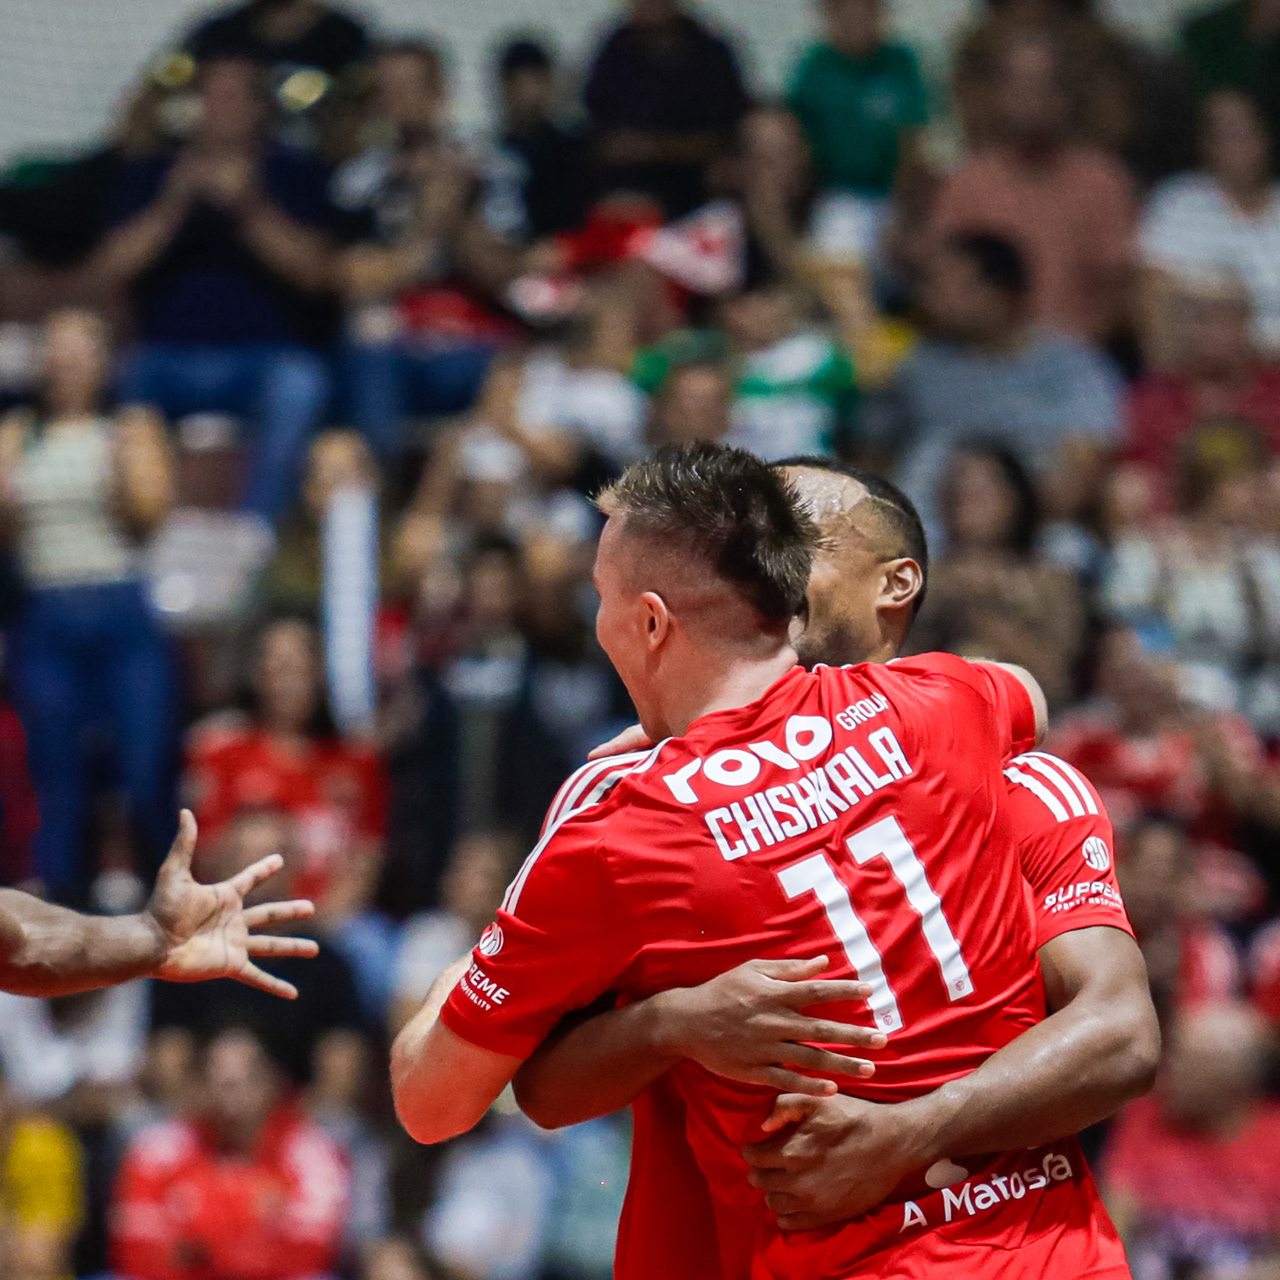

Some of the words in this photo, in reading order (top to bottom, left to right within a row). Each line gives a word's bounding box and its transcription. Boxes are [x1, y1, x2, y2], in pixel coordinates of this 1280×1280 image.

[704, 726, 914, 861] CHISHKALA
[777, 814, 975, 1035] 11
[899, 1200, 928, 1233] A
